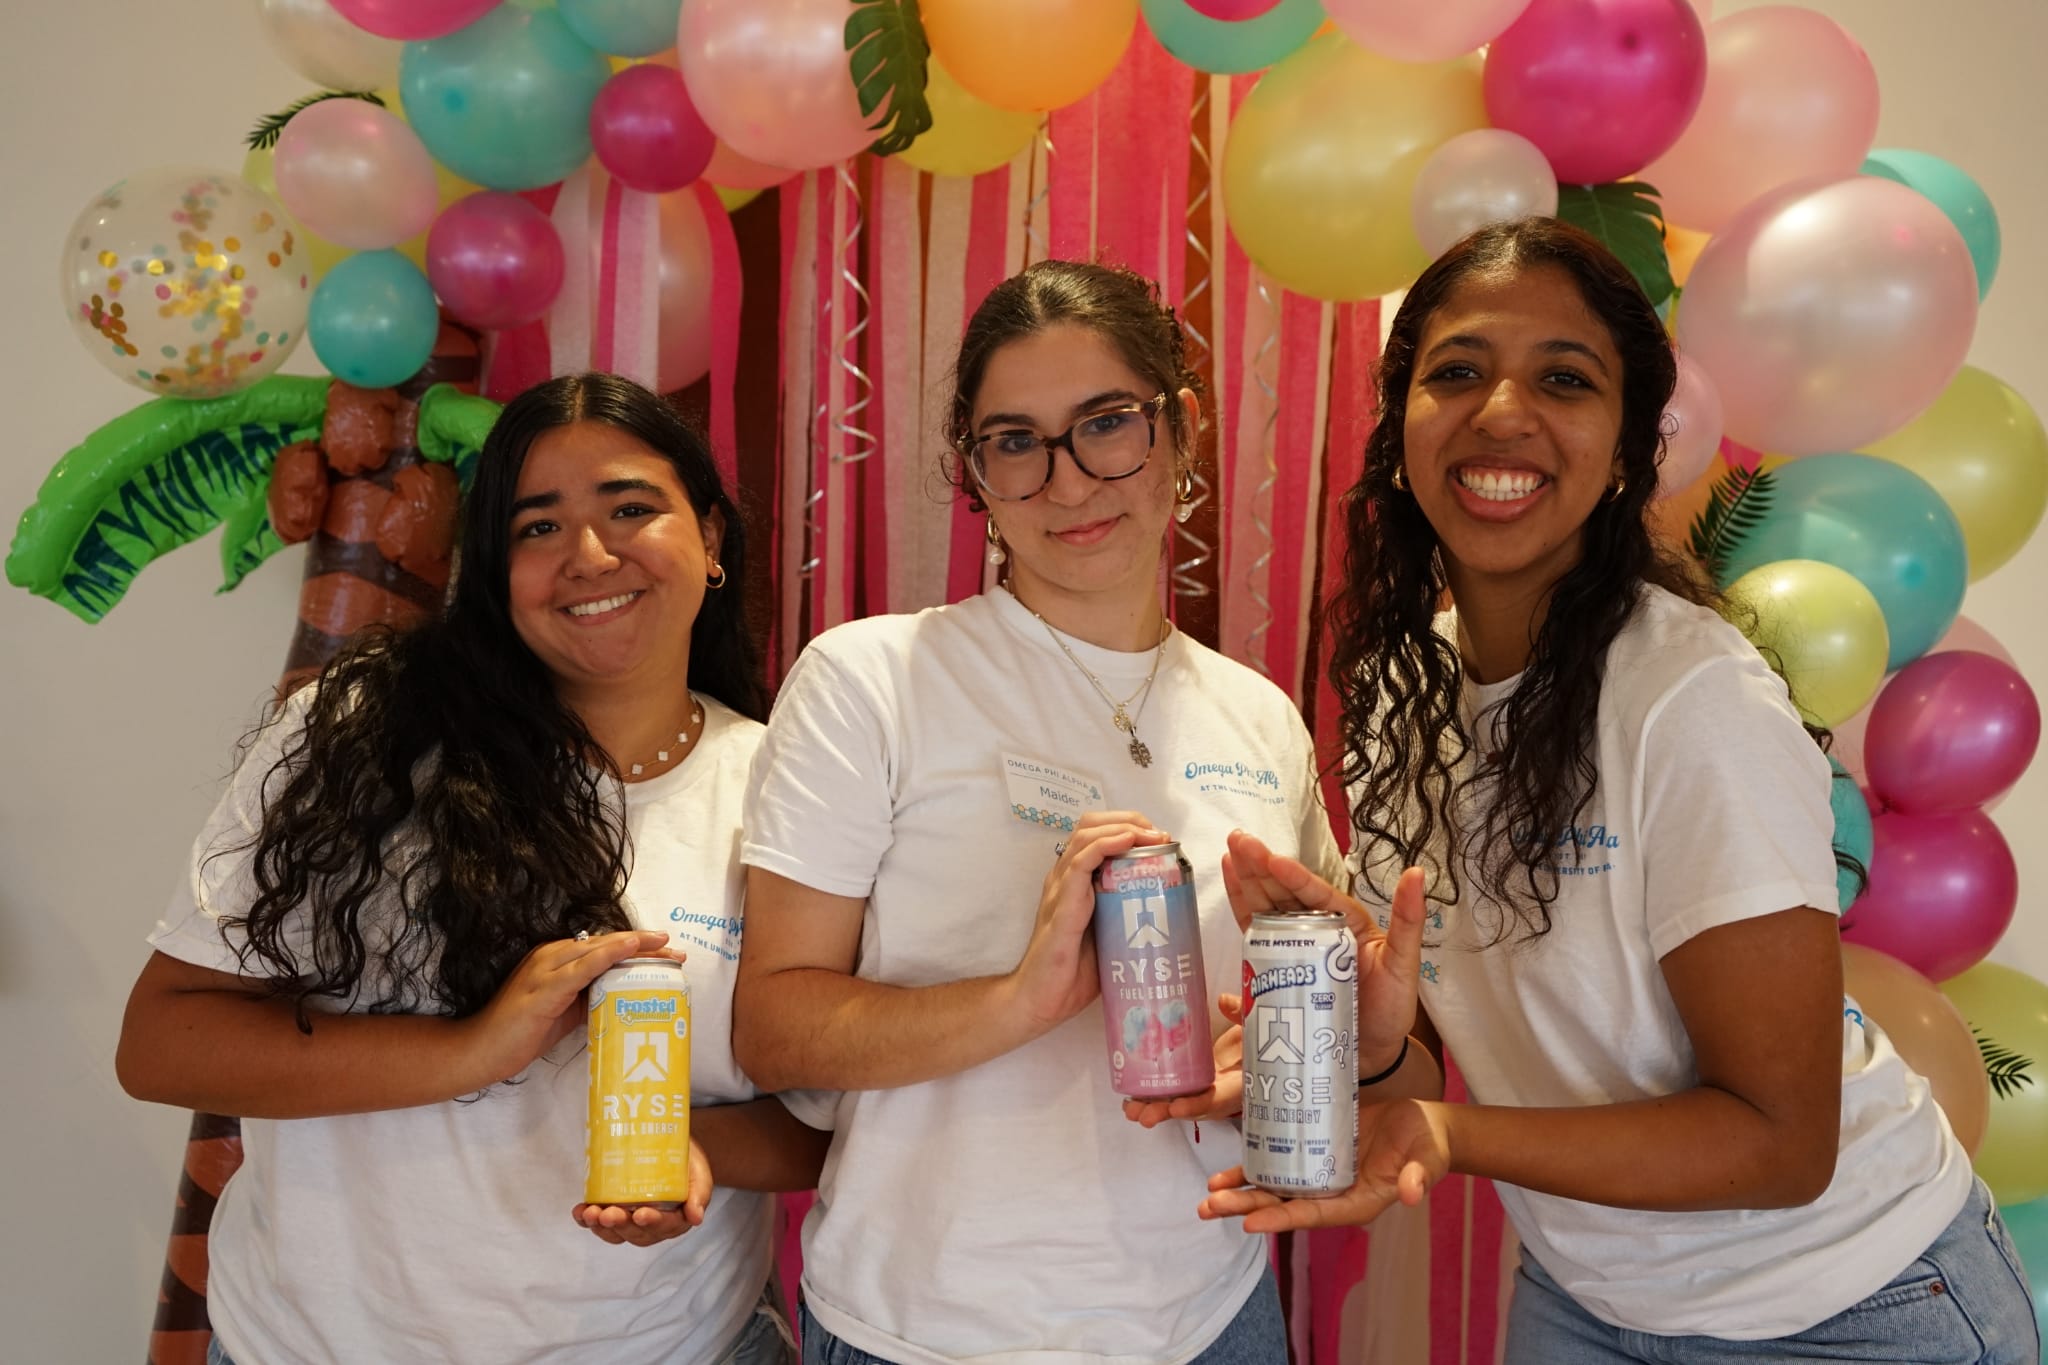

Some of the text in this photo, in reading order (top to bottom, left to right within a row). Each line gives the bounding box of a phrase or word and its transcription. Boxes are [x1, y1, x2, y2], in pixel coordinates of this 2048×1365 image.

[1007, 759, 1090, 789] OMEGA PHI ALPHA
[1185, 761, 1233, 779] Omega
[1039, 786, 1081, 808] Maider
[1200, 784, 1211, 792] AT
[1587, 864, 1601, 875] OF
[1118, 876, 1167, 894] CANDY
[670, 906, 727, 931] Omega
[680, 932, 692, 941] AT
[693, 936, 708, 949] THE
[1272, 939, 1316, 948] MYSTERY
[1111, 953, 1193, 985] RYSE
[1250, 964, 1317, 999] AIRHEADS
[1120, 986, 1142, 1000] FUEL
[1312, 993, 1335, 1003] ZERO
[616, 998, 677, 1014] Frosted
[1244, 1071, 1331, 1105] RYSE
[603, 1093, 684, 1120] RYSE
[1248, 1103, 1321, 1124] FUEL ENERGY
